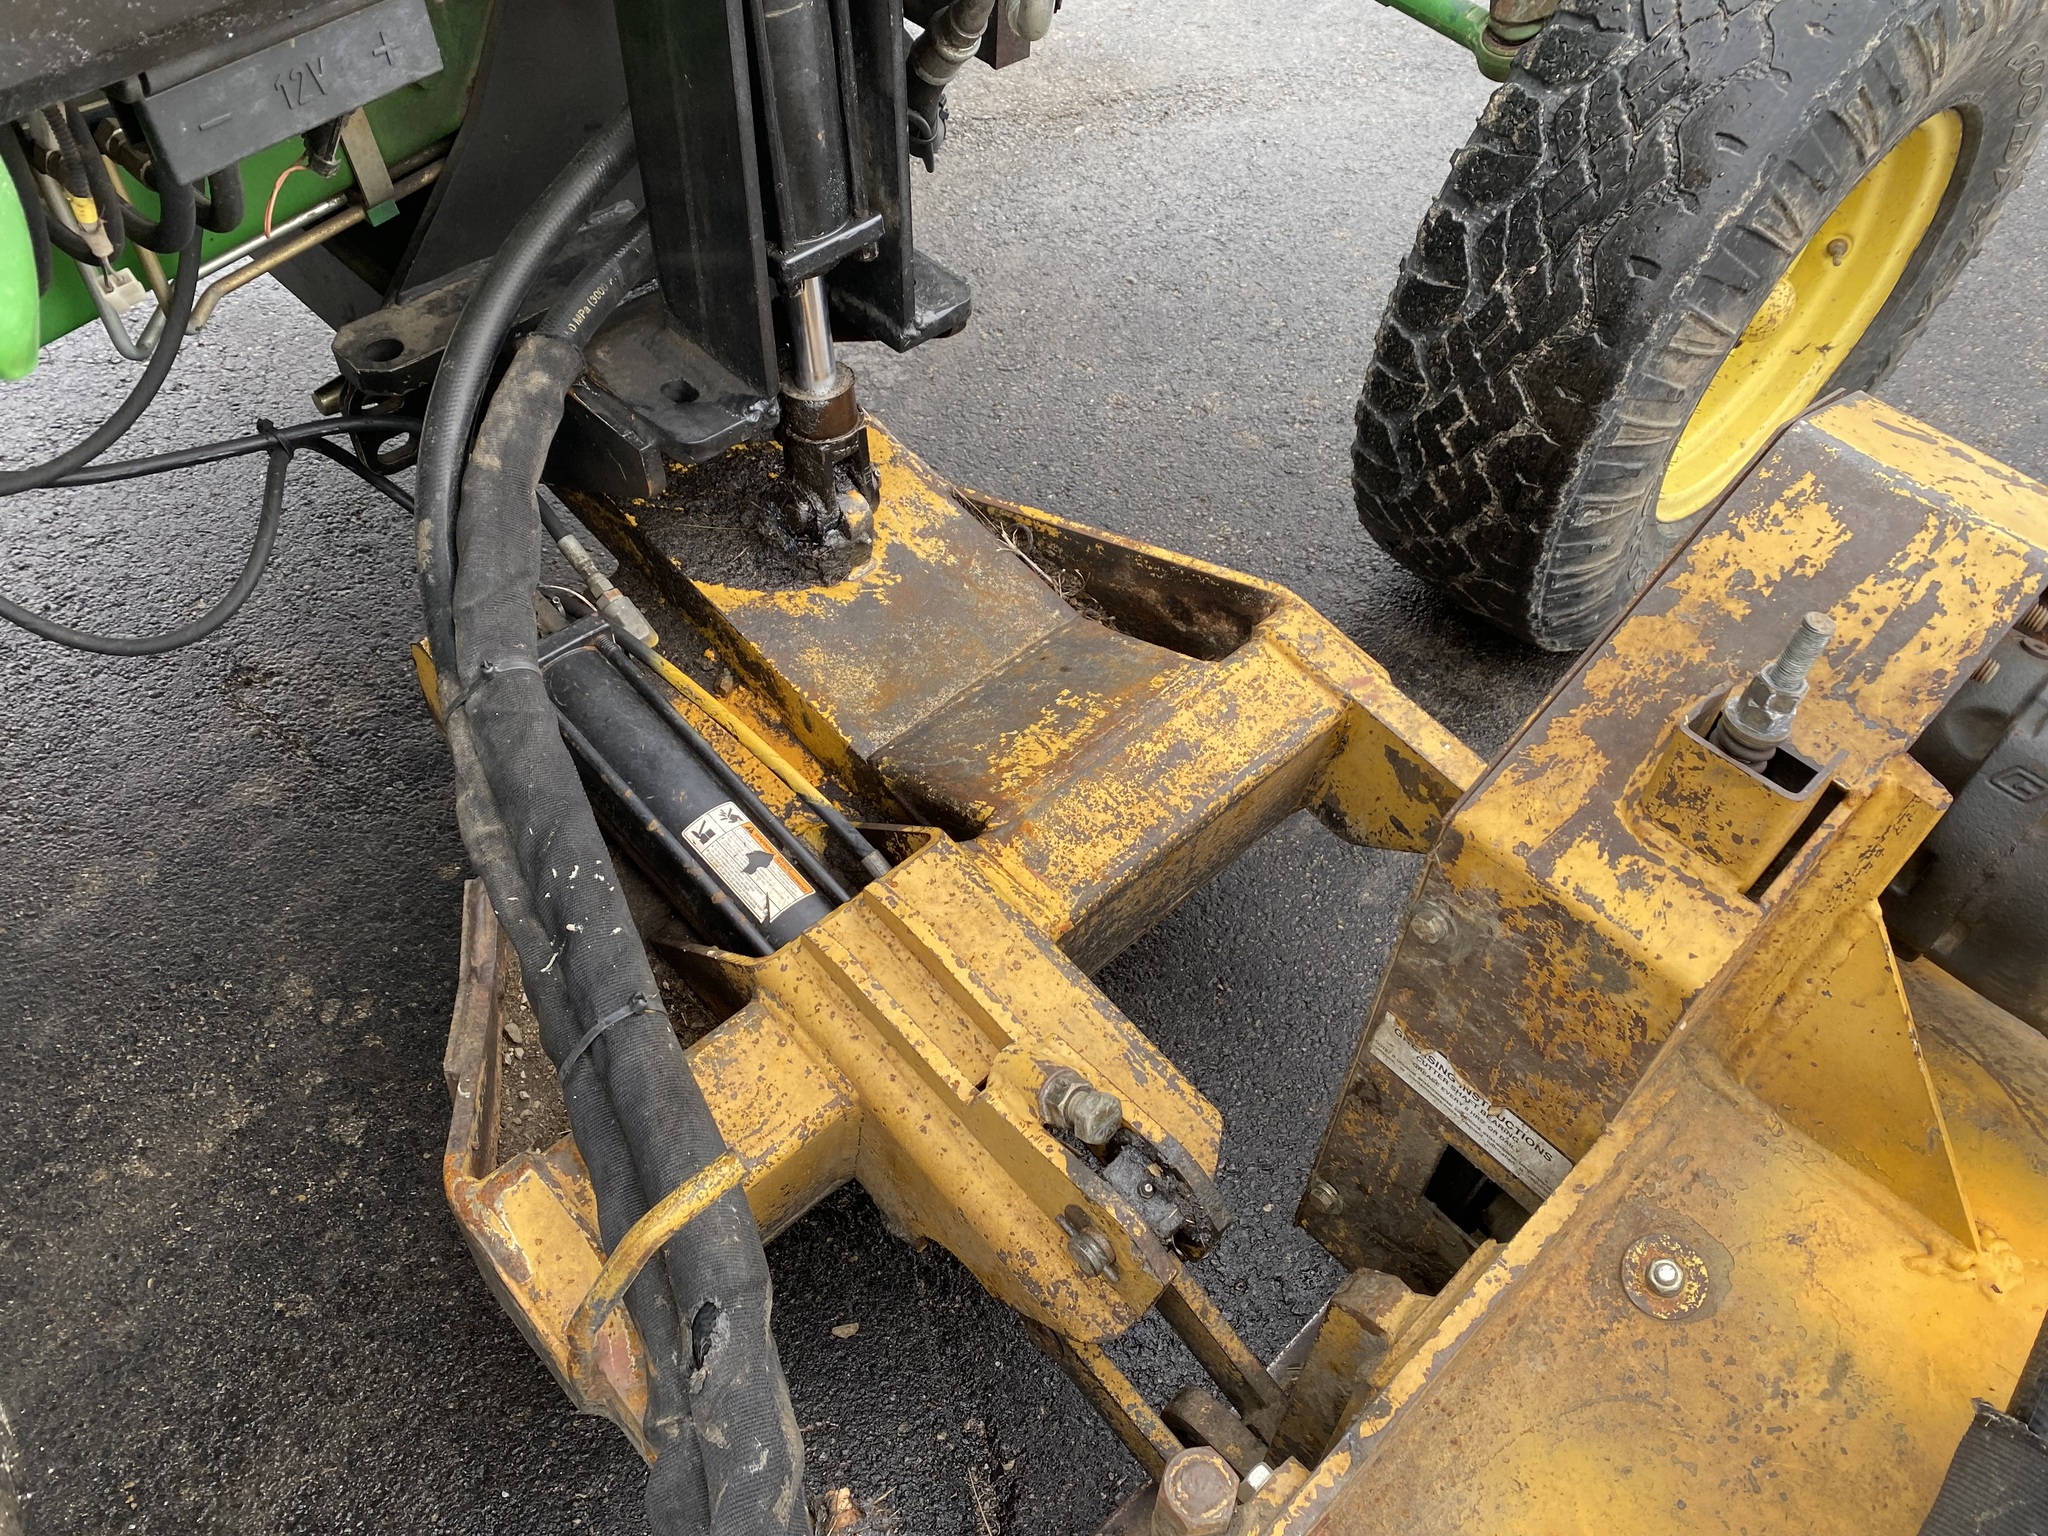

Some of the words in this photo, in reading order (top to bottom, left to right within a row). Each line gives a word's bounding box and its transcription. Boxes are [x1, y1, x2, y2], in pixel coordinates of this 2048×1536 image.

[274, 55, 328, 110] 12V
[572, 303, 591, 326] MPa
[1449, 1084, 1478, 1109] SHAFT
